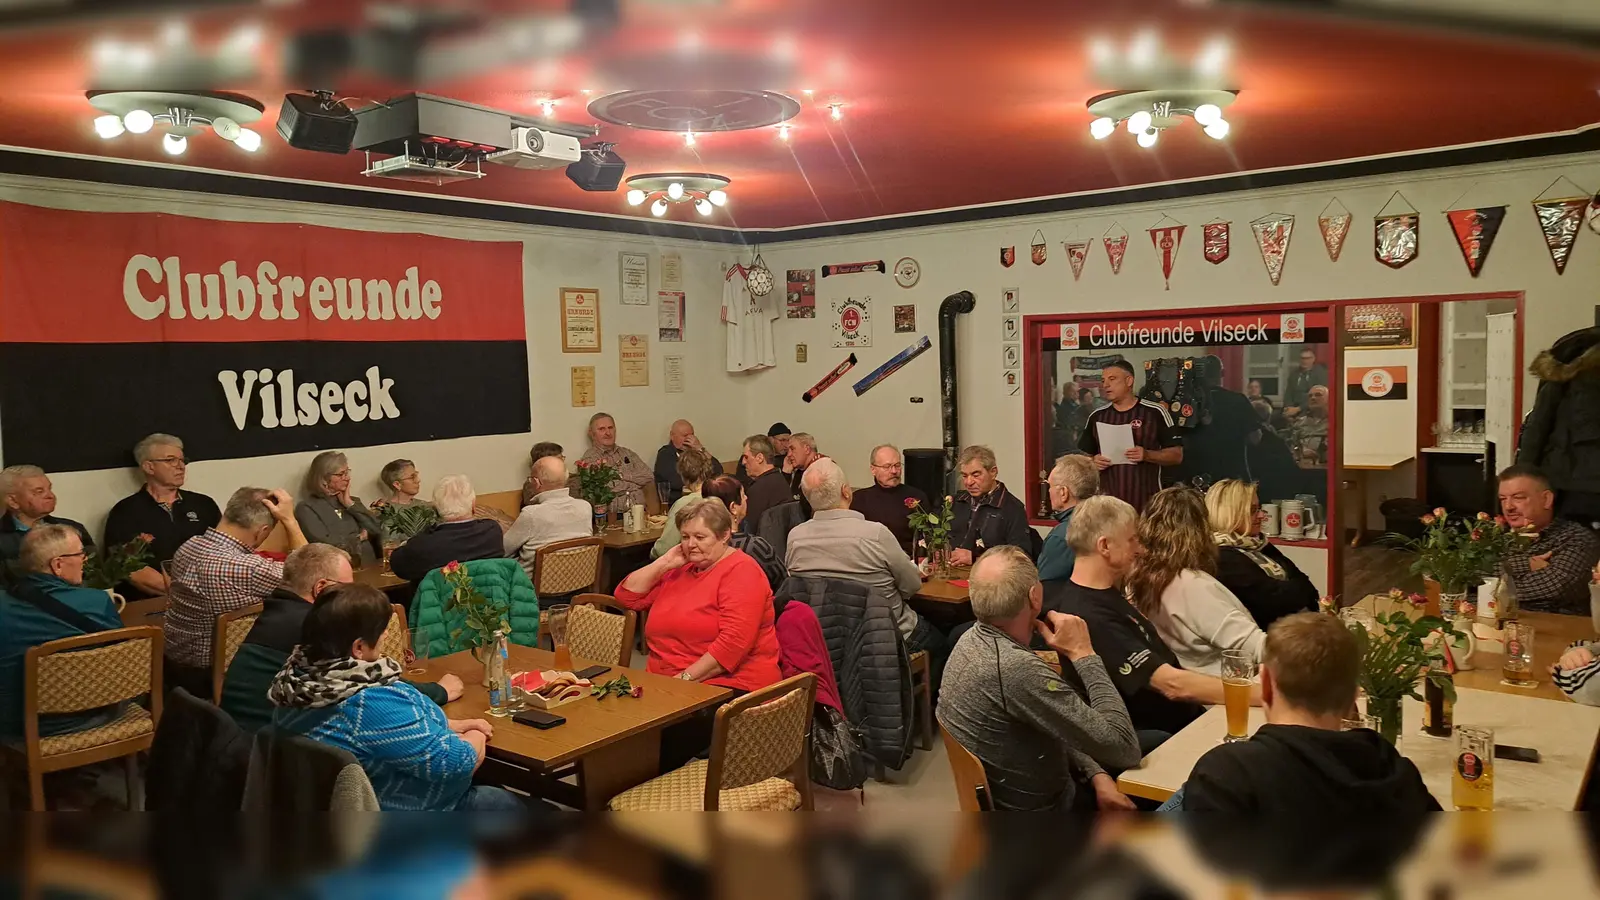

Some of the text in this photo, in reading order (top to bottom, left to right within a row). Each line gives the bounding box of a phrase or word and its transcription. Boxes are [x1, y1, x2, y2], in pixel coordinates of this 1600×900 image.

[123, 254, 442, 321] Clubfreunde
[1089, 318, 1268, 346] Clubfreunde Vilseck
[217, 366, 400, 430] Vilseck
